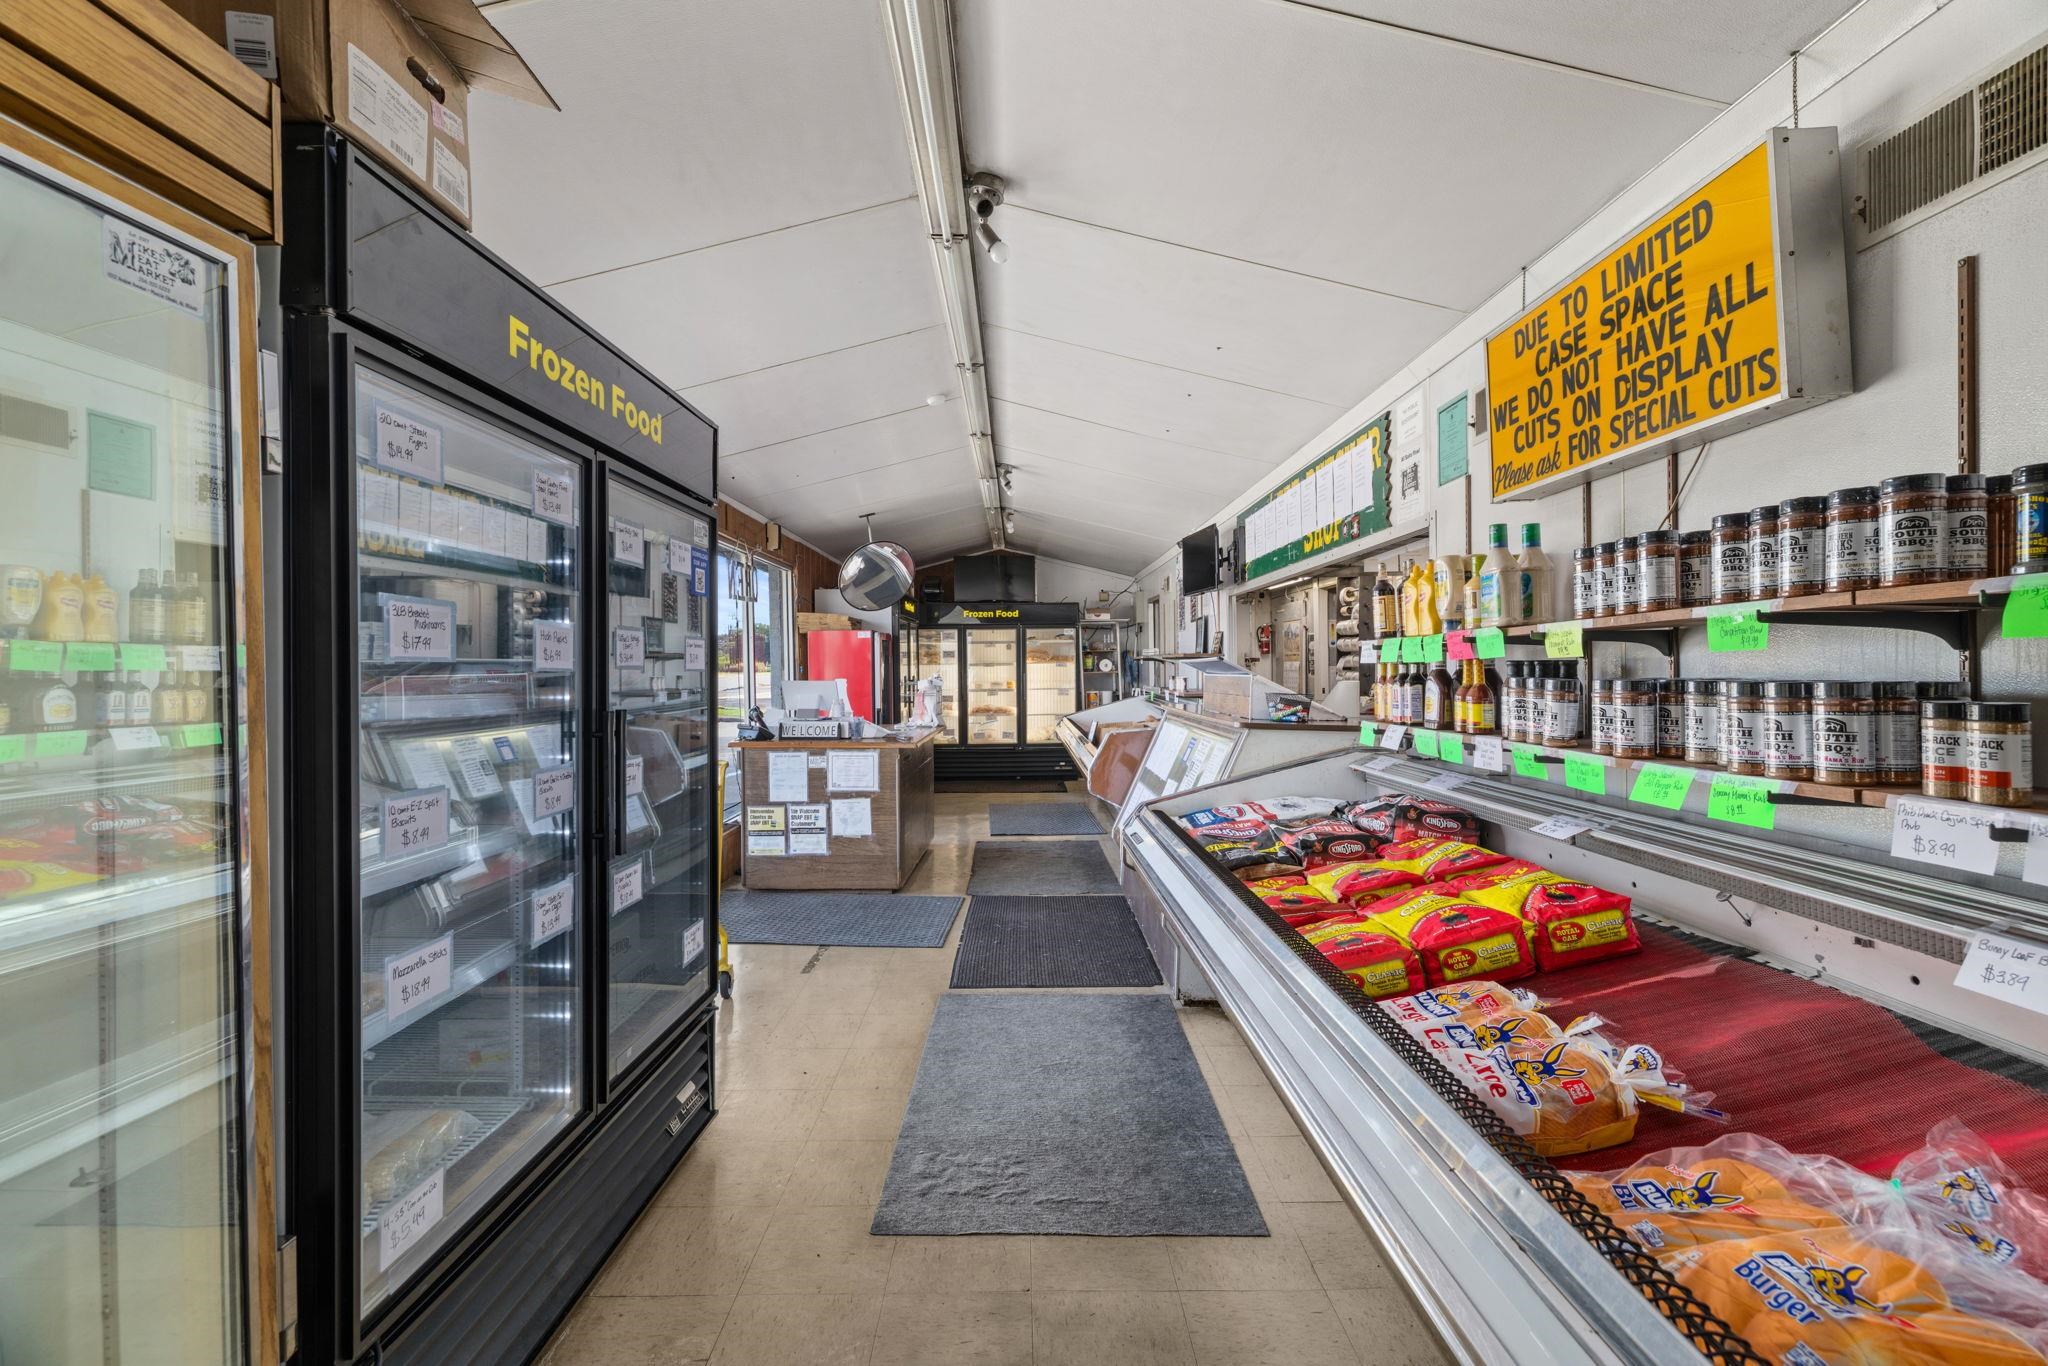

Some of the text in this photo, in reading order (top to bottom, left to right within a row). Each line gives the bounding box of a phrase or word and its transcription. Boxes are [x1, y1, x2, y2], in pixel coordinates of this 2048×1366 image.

[1515, 200, 1712, 359] DUE TO LIMITED
[1535, 261, 1684, 376] CASE SPACE
[1493, 261, 1768, 432] WE DO NOT HAVE ALL
[510, 314, 662, 444] Frozen Food
[1514, 408, 1560, 453] CUTS
[1573, 389, 1601, 425] ON
[1615, 320, 1733, 410] DISPLAY
[1495, 348, 1776, 493] Please ask FOR SPECIAL CUTS
[1898, 538, 1927, 547] BBQ
[414, 619, 446, 631] Mushrooms
[782, 725, 837, 736] WELCOME
[1815, 733, 1858, 742] OUTH
[391, 814, 416, 828] Biscuits
[1426, 817, 1458, 828] KINGSFORD
[1940, 810, 1967, 826] Cajun
[1332, 843, 1362, 854] KINGSFORD
[1912, 834, 1956, 858] $8.99
[1556, 928, 1580, 936] ROYAL
[1978, 939, 2009, 960] Bunny
[1448, 955, 1471, 964] ROYAL
[1392, 998, 1429, 1023] Large
[1734, 1258, 1823, 1324] Burger
